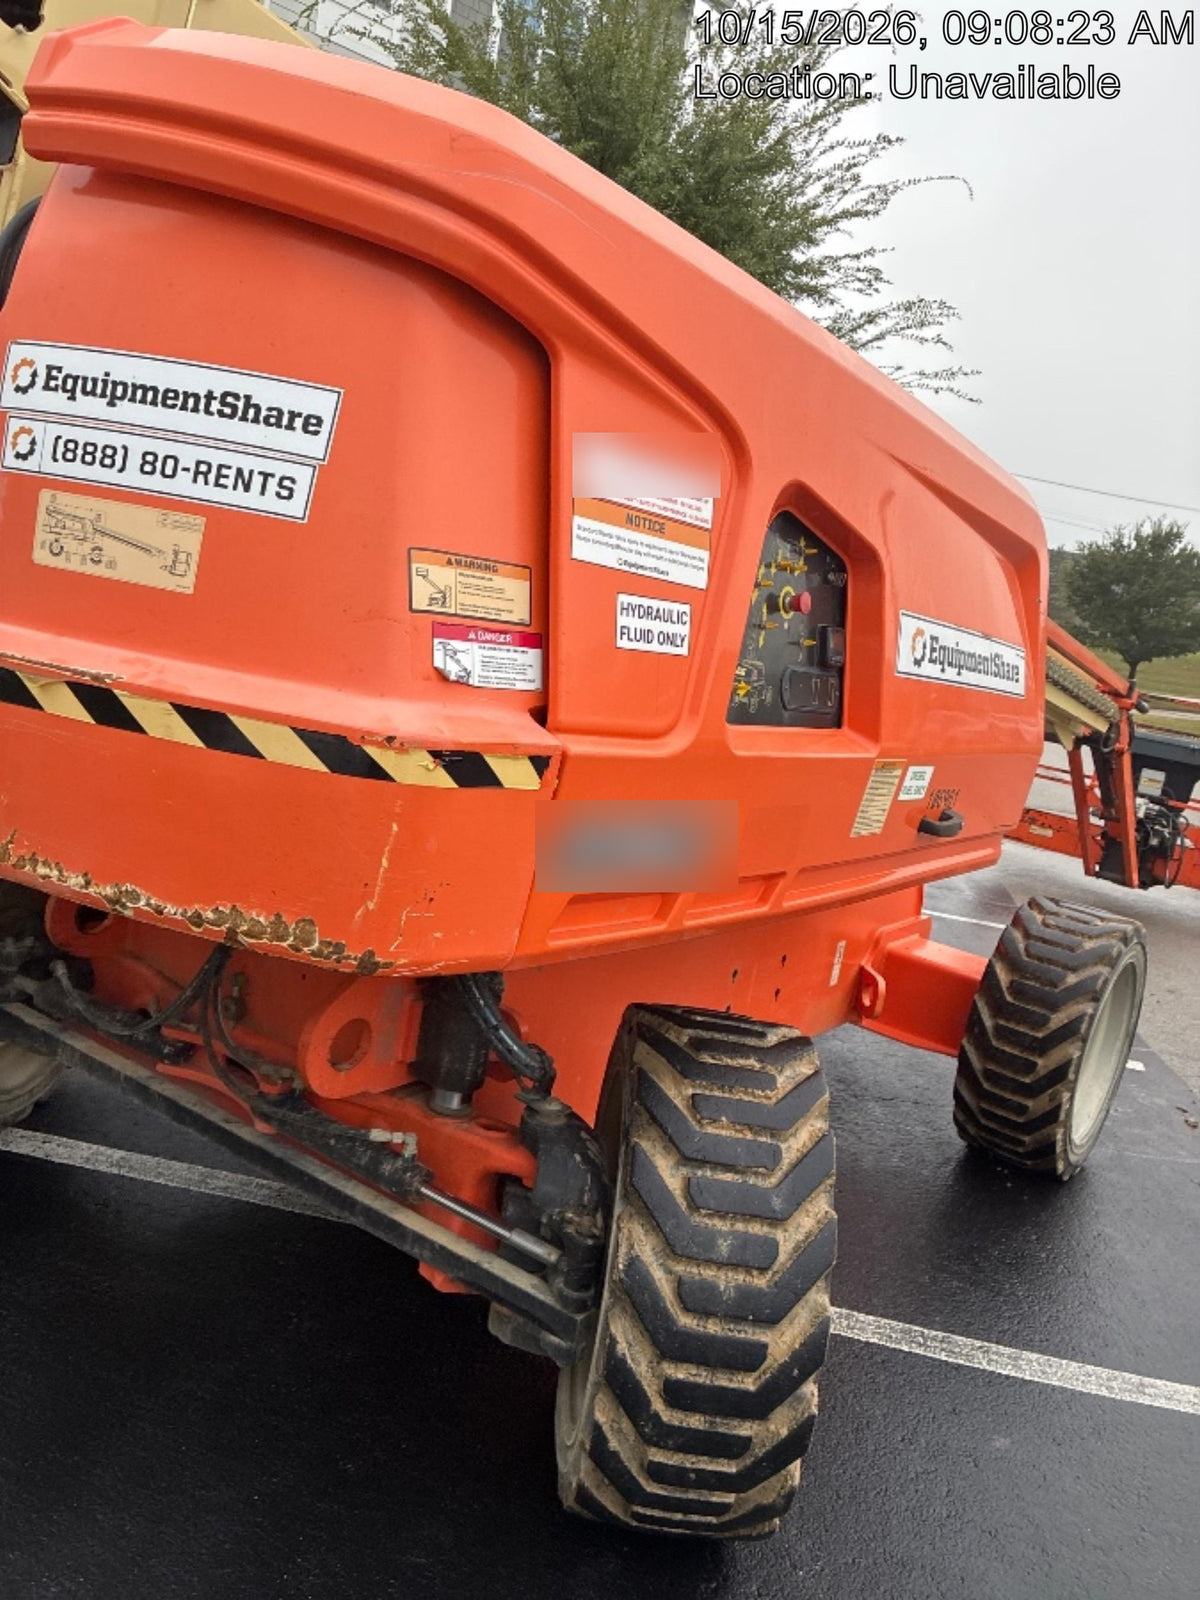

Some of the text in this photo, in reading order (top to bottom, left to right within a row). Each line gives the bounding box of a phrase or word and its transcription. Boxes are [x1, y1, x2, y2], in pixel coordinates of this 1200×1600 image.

[42, 364, 324, 436] EquipmentShare
[51, 435, 297, 501] (888) 80-RENTS
[625, 512, 667, 534] NOTICE
[455, 558, 498, 573] WARNING
[620, 600, 689, 626] HYDRAULIC
[478, 631, 512, 643] DANGER
[620, 625, 687, 648] FLUID ONLY
[928, 635, 1020, 683] EquipmentShare
